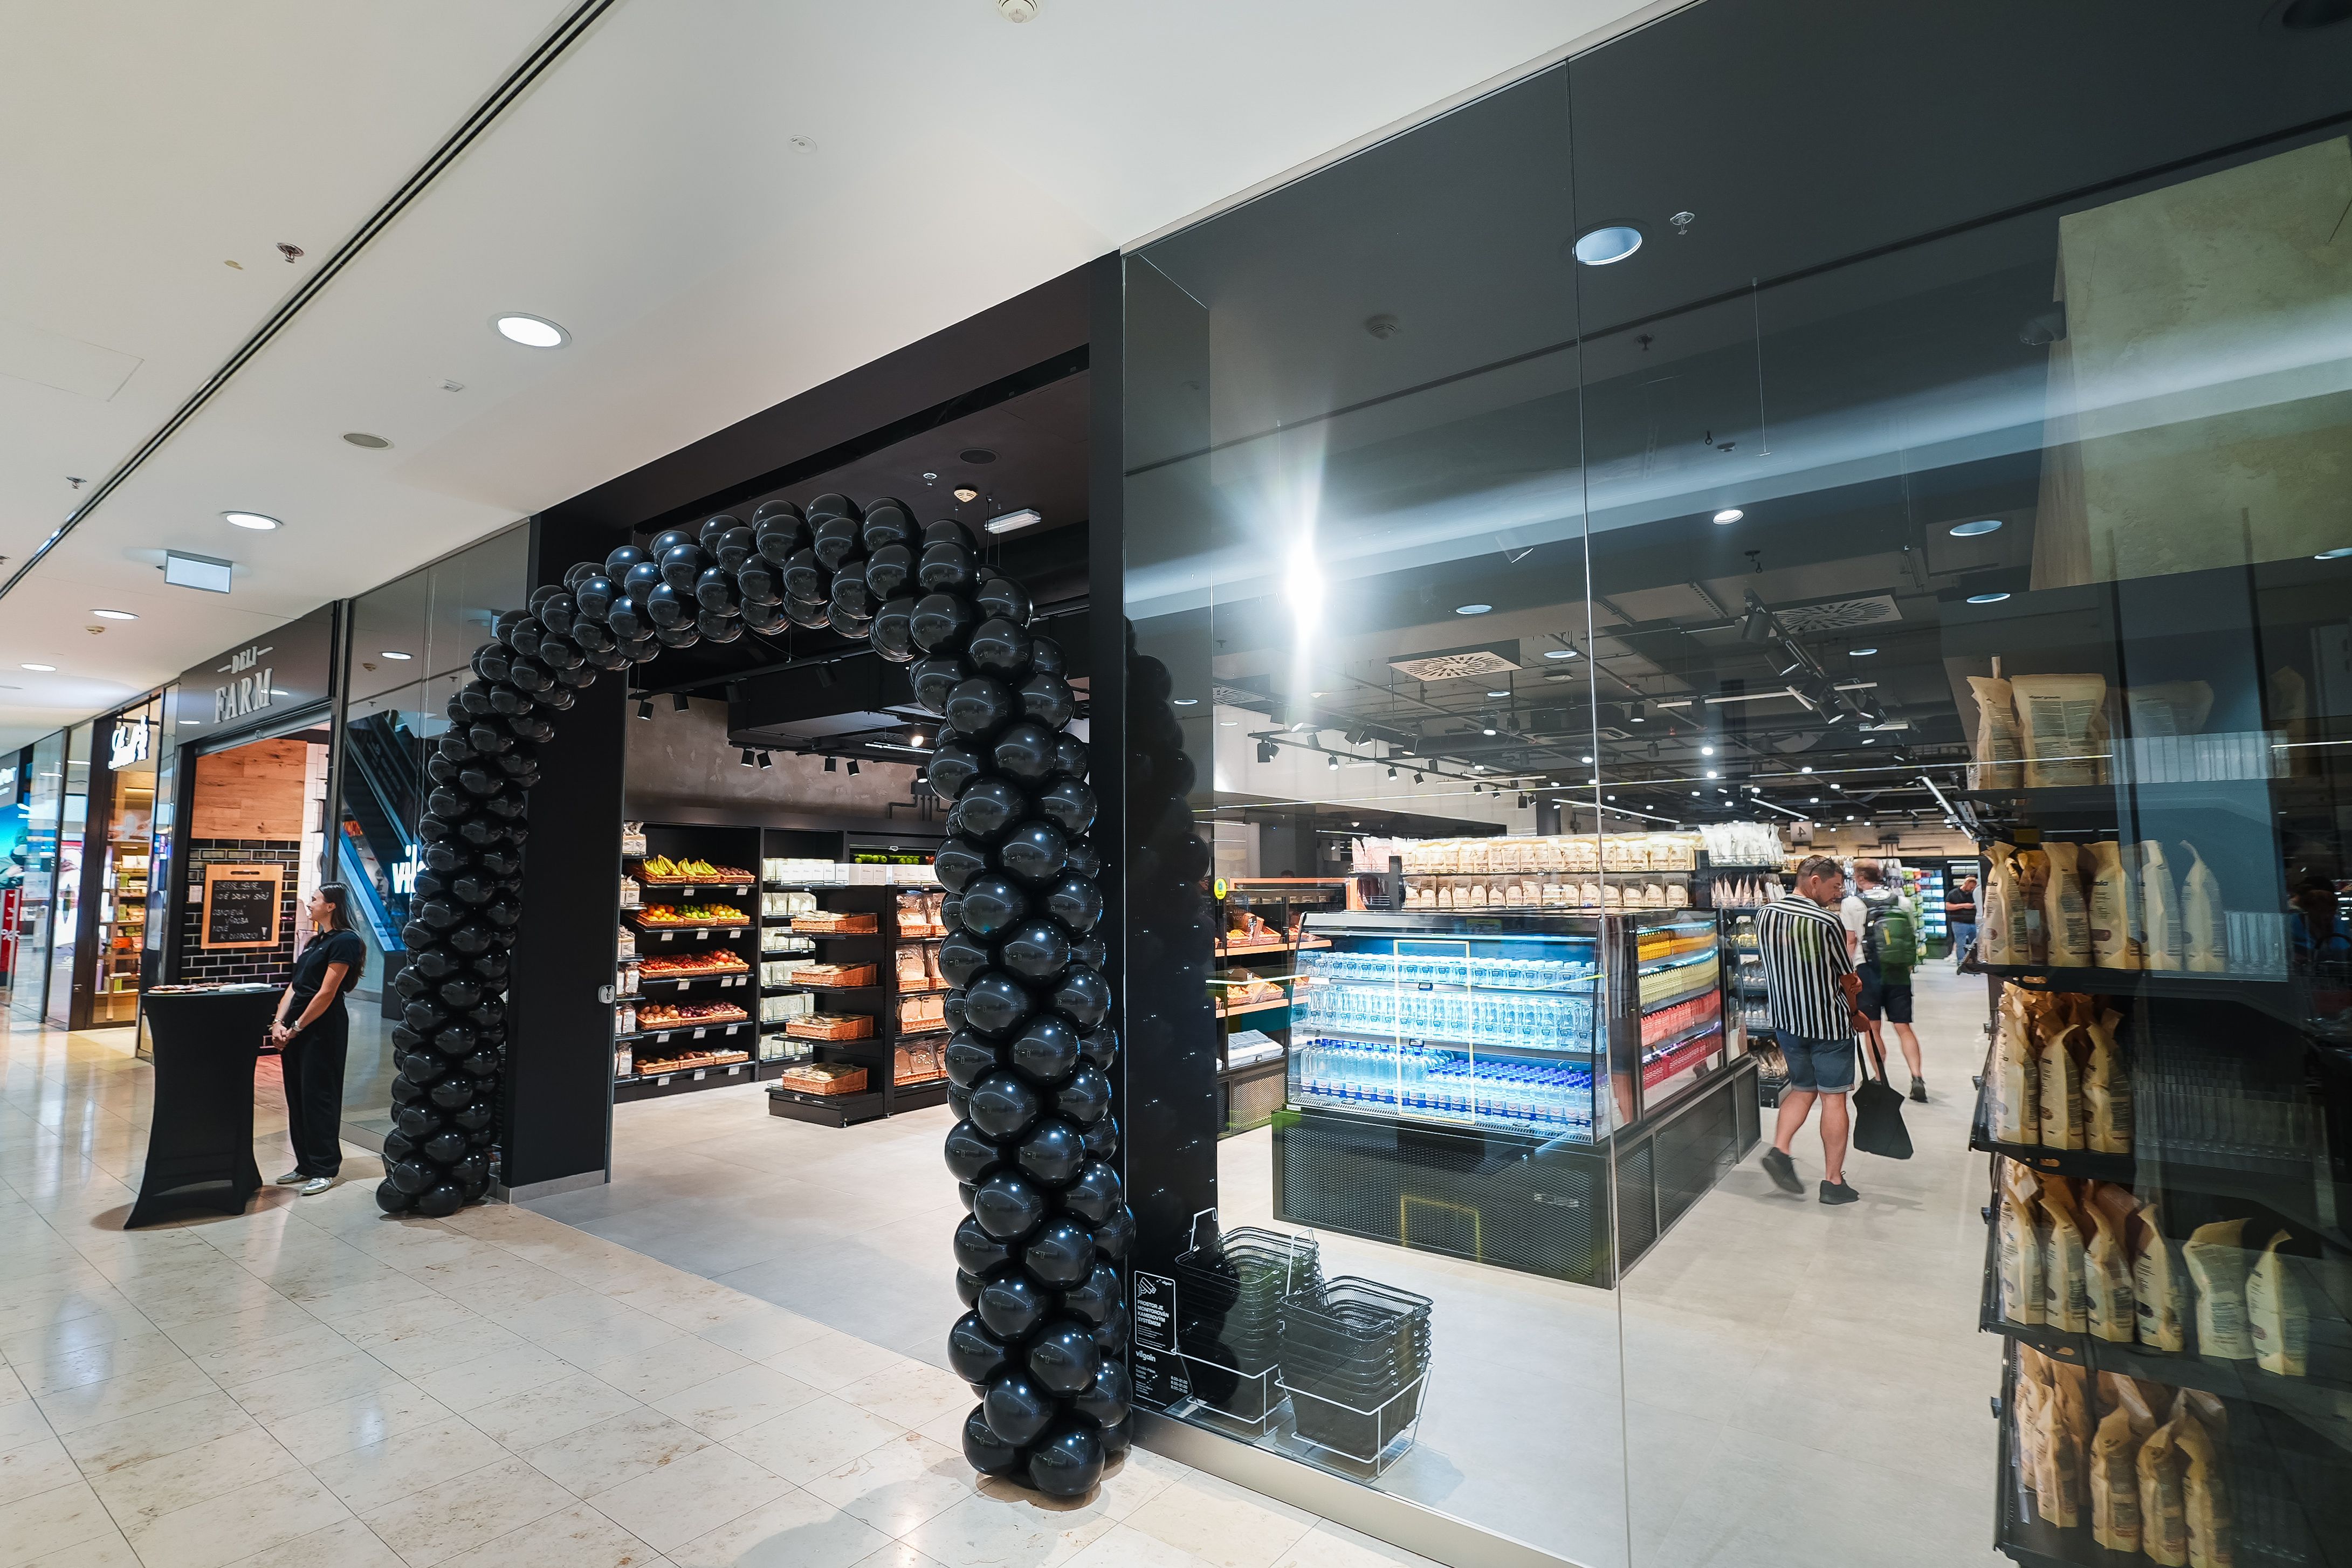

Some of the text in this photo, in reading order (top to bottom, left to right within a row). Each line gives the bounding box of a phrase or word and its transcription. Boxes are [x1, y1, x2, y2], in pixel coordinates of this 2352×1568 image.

[231, 646, 258, 674] DELI
[214, 668, 273, 724] FARM
[392, 844, 427, 893] vil
[1137, 1299, 1158, 1309] PROSTOR
[1137, 1305, 1170, 1318] MONITOROVÁN
[1137, 1311, 1166, 1323] KAMEROVÝM
[1138, 1317, 1161, 1328] SYSTÉMEM
[1136, 1350, 1156, 1362] vilgain
